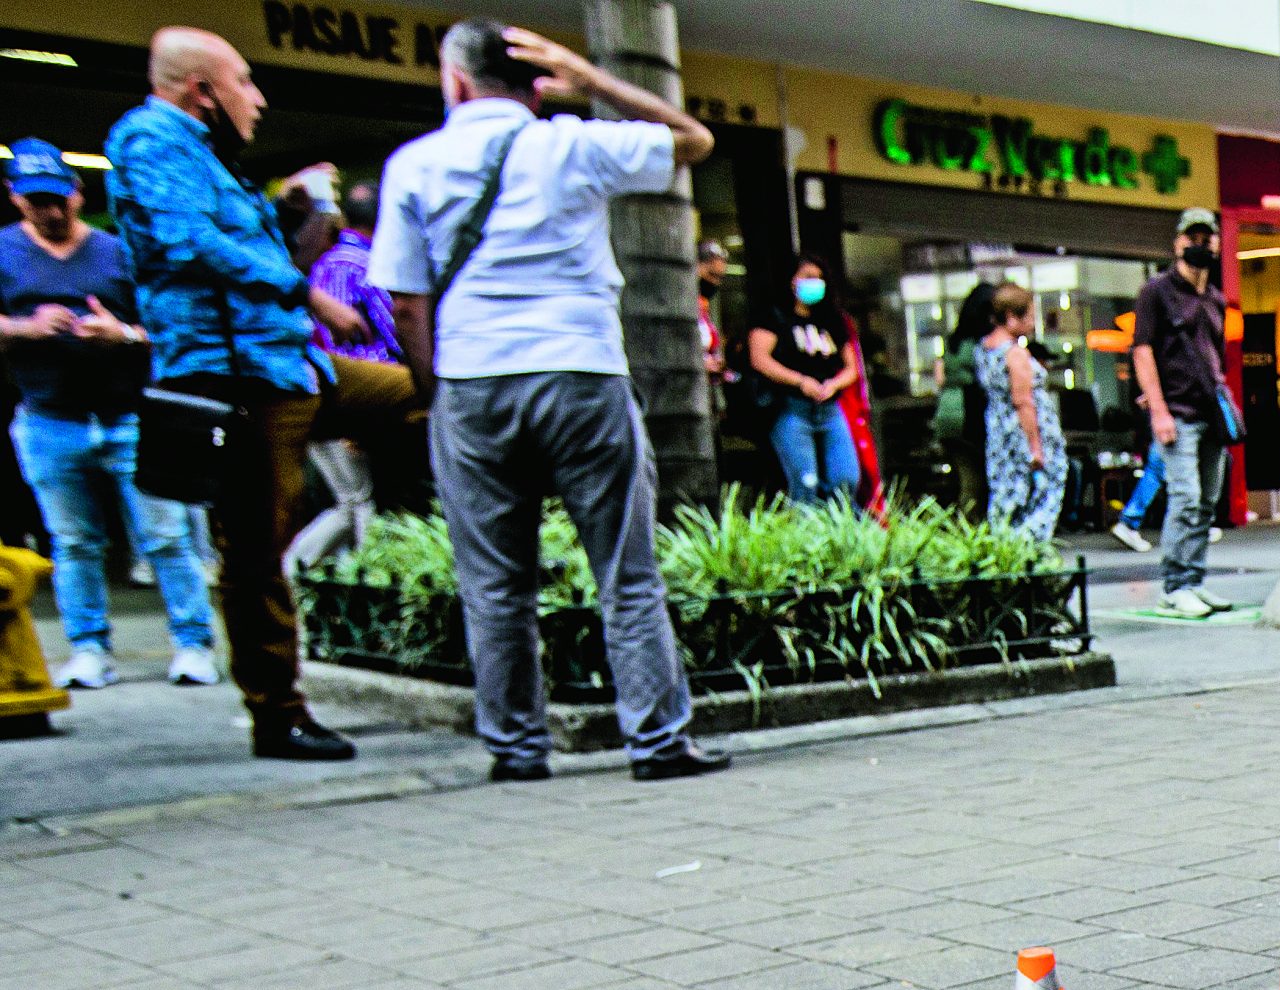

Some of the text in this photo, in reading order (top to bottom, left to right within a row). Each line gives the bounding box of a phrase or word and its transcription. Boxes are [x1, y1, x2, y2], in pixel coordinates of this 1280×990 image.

[263, 1, 448, 70] PASAJE A
[872, 98, 994, 170] Cruz
[990, 112, 1140, 189] Verde
